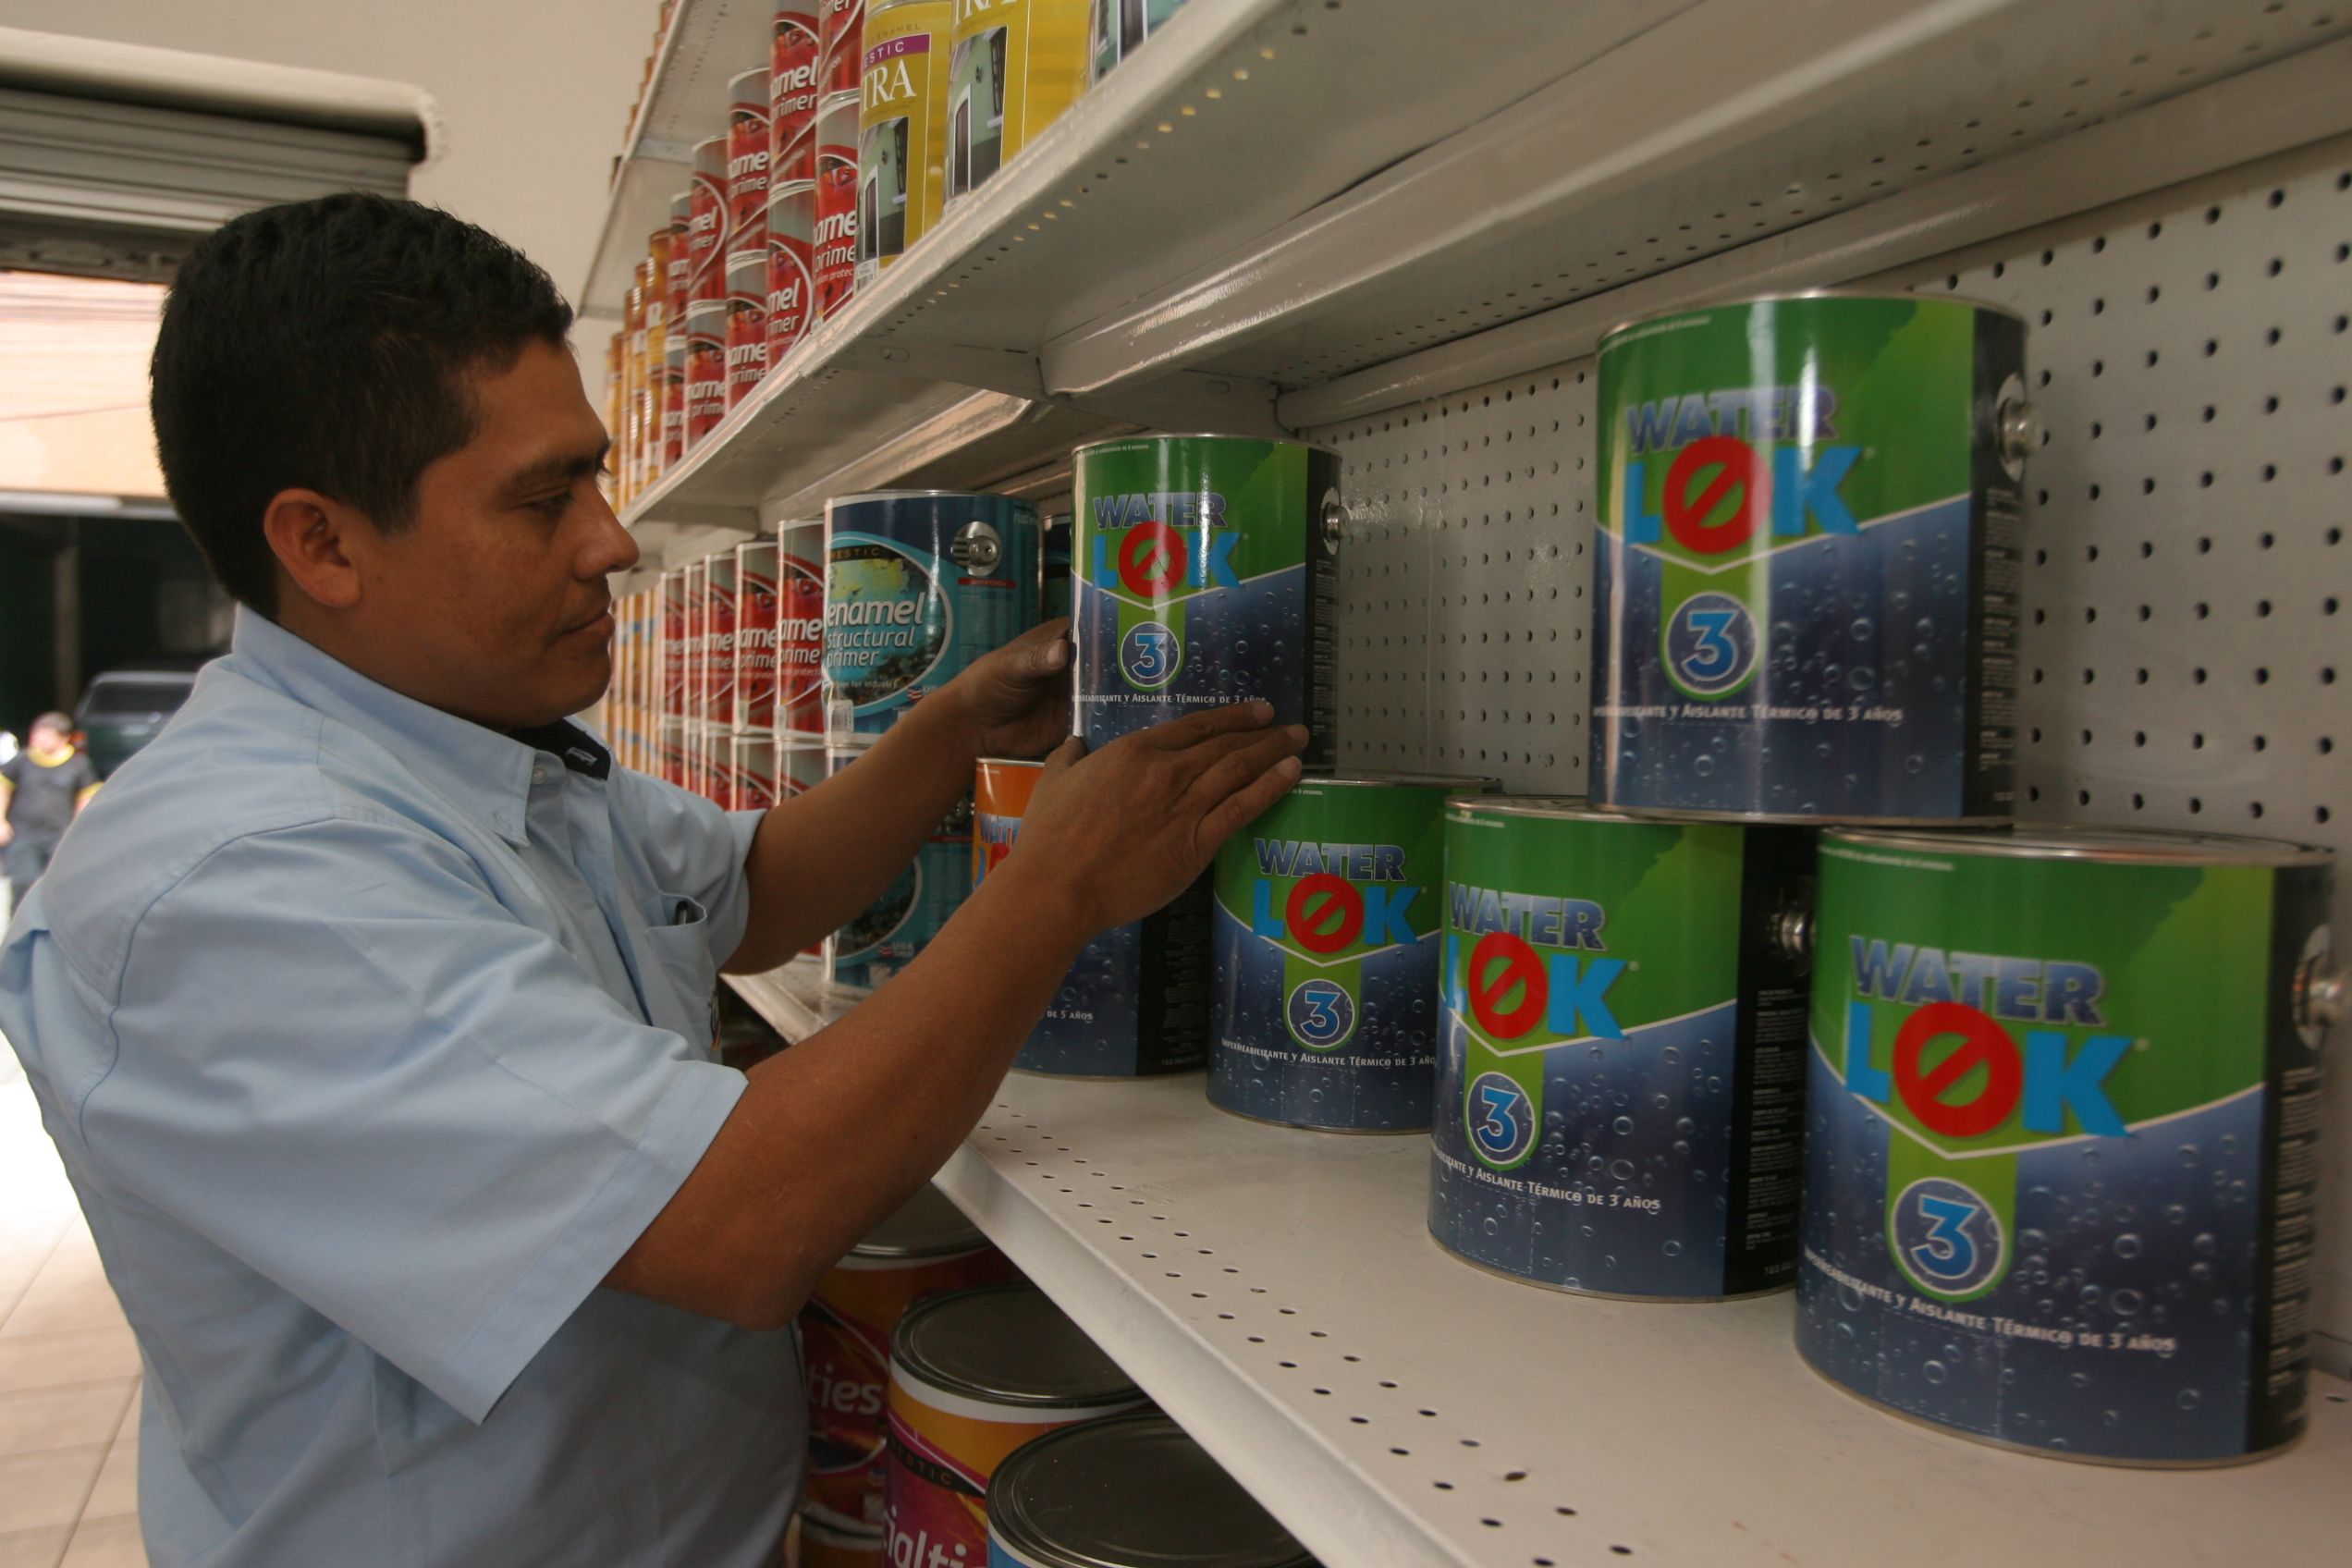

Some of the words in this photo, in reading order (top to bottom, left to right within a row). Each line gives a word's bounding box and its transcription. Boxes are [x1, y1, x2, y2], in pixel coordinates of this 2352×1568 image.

[864, 42, 905, 68] ESTIC
[861, 59, 918, 113] TRA
[815, 211, 857, 248] ame
[815, 245, 855, 274] prime
[1624, 384, 1839, 455] WATER
[1093, 492, 1229, 530] WATER
[826, 592, 925, 628] enamel
[827, 626, 915, 648] structural
[827, 647, 880, 668] primer
[1131, 633, 1167, 679] 3
[1682, 610, 1738, 681] 3
[1133, 693, 1172, 703] AISLANTE
[1175, 693, 1216, 704] TÉRMICO
[1219, 695, 1231, 704] DE
[1234, 695, 1240, 704] 3
[1682, 704, 1746, 718] AISLANTE
[1822, 707, 1843, 720] DE
[1847, 705, 1858, 720] 3
[1255, 837, 1406, 881] WATER
[1447, 879, 1607, 953] WATER
[1850, 934, 2108, 1028] WATER
[1047, 1011, 1058, 1019] DE
[1060, 1010, 1066, 1019] 5
[1069, 1010, 1094, 1021] AÑOS
[1300, 990, 1341, 1039] 3
[1292, 1053, 1297, 1061] Y
[1300, 1053, 1345, 1065] AISLANTE
[1349, 1056, 1391, 1066] TÉRMICO
[1395, 1058, 1406, 1066] DE
[1410, 1057, 1415, 1066] 3
[1419, 1056, 1436, 1065] AÑO
[1476, 1084, 1518, 1154] 3
[1468, 1166, 1475, 1177] Y
[1476, 1168, 1524, 1192] AISLANTE
[1527, 1181, 1582, 1202] TÉRMICO
[1587, 1194, 1604, 1205] DE
[1609, 1194, 1618, 1207] 3
[1623, 1195, 1660, 1209] AÑOS
[1911, 1194, 1978, 1279] 3
[1908, 1296, 1987, 1329] AISLANTE
[1991, 1315, 2073, 1344] TÉRMICO
[2078, 1332, 2102, 1348] DE
[2108, 1330, 2123, 1349] 3
[2127, 1333, 2177, 1353] AÑOS
